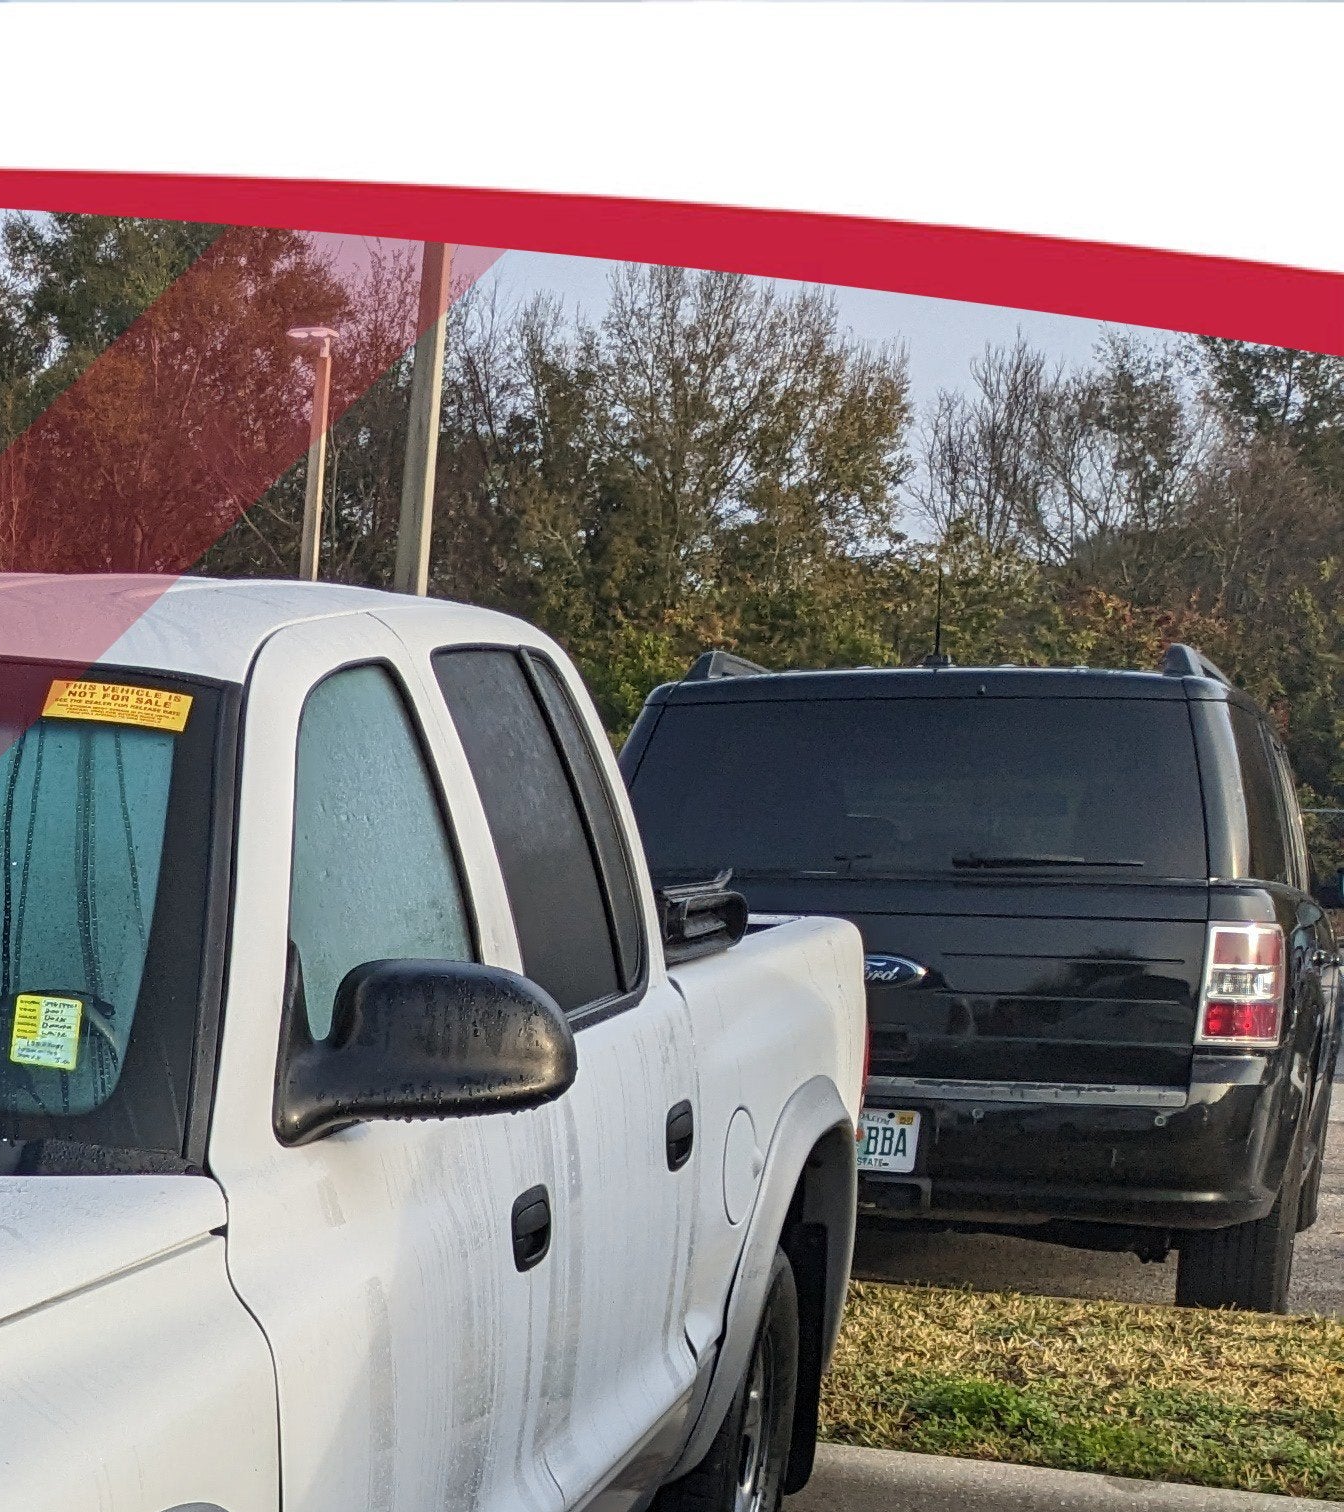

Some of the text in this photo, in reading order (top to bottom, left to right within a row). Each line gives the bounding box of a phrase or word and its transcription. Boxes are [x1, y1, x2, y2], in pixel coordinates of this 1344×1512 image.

[64, 682, 182, 703] THIS VEHICLE IS
[67, 690, 172, 709] NOT FOR SALE
[863, 1126, 907, 1157] BBA
